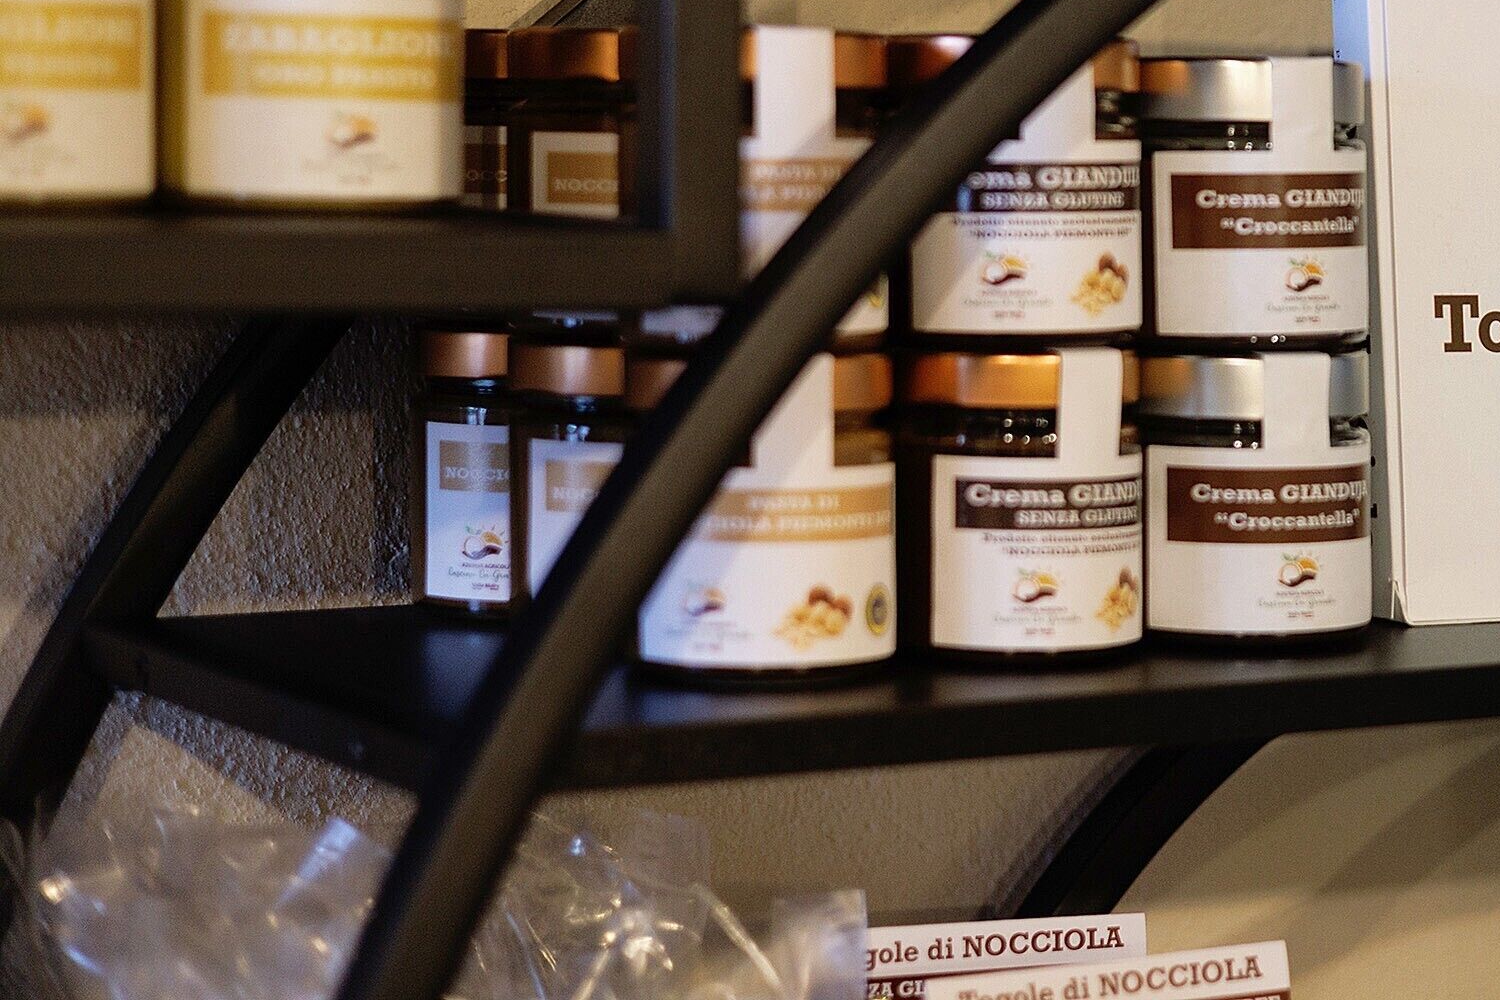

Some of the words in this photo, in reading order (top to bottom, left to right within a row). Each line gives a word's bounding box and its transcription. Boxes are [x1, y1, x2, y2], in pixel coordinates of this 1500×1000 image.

[1195, 188, 1282, 210] Crema
[963, 482, 1067, 509] Crema
[1190, 482, 1277, 504] Crema
[1013, 509, 1081, 529] SENZA
[927, 936, 955, 961] di
[962, 925, 1125, 958] NOCCIOLA
[1063, 978, 1090, 1000] di
[1097, 955, 1263, 998] NOCCIOLA
